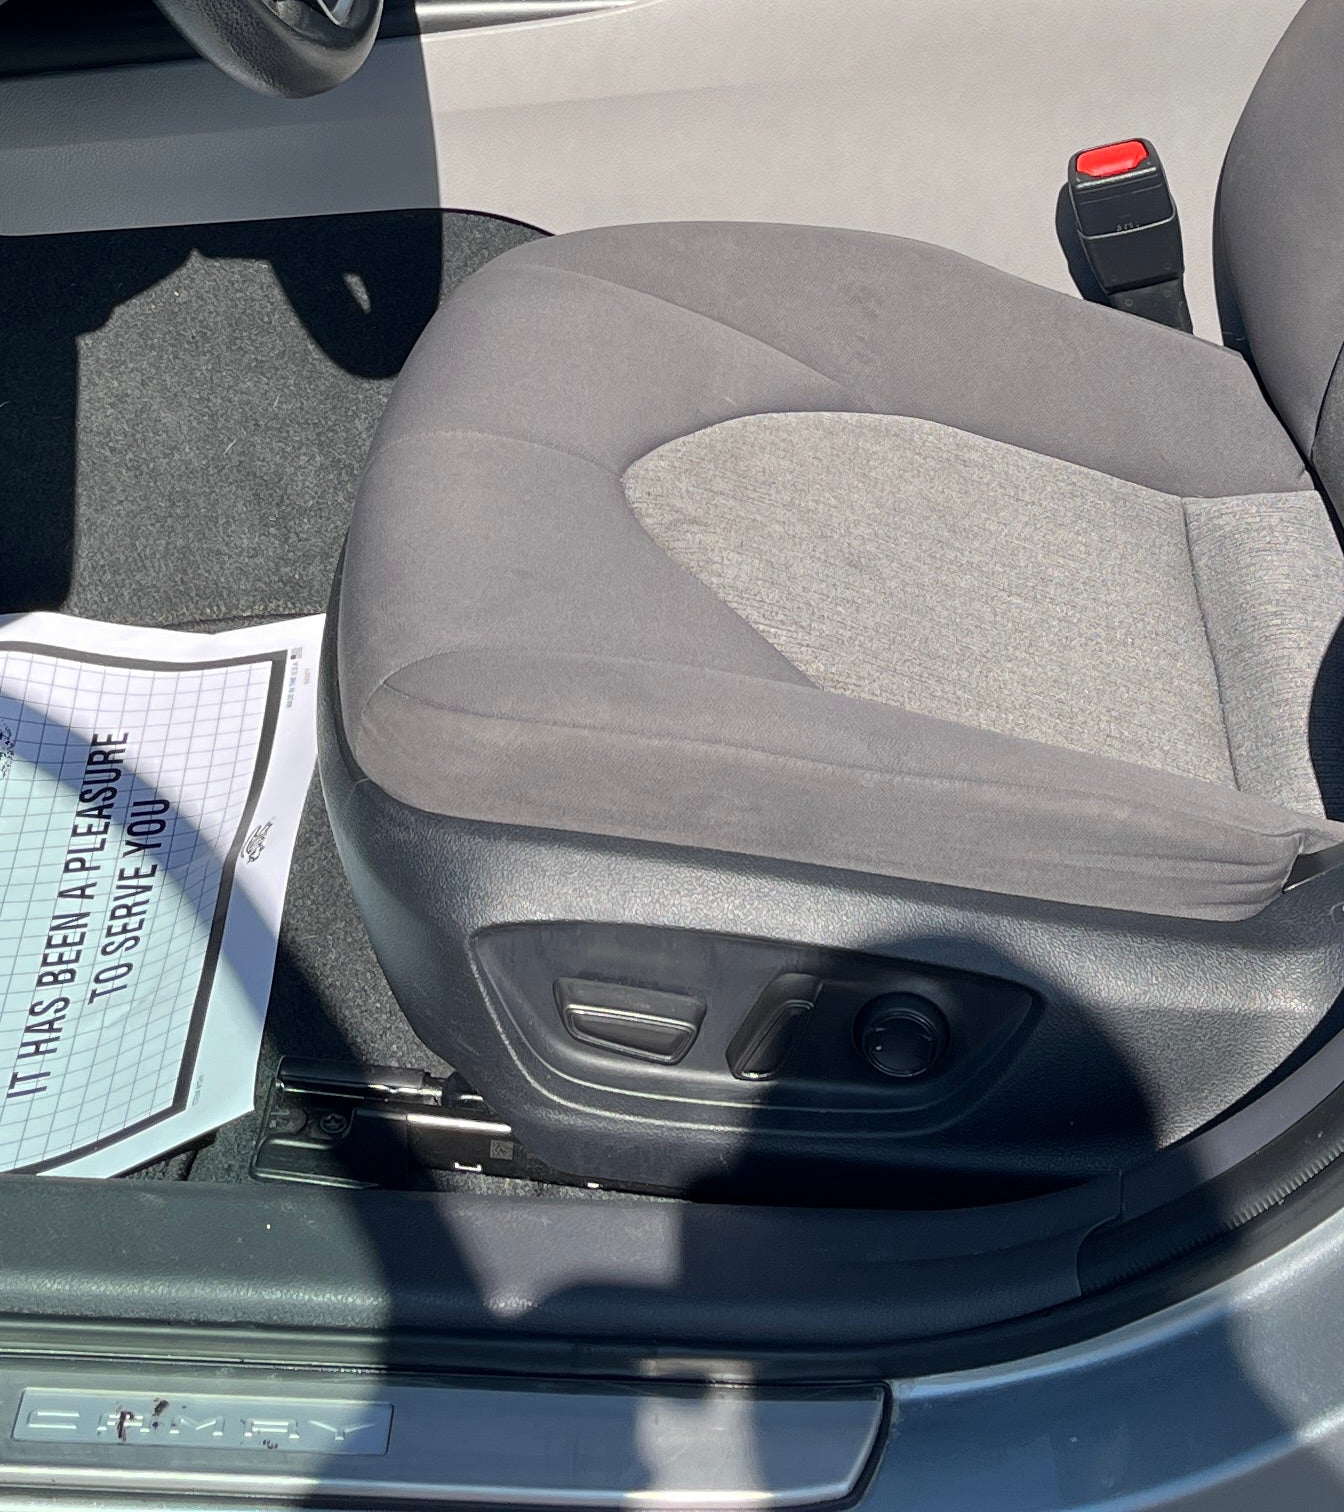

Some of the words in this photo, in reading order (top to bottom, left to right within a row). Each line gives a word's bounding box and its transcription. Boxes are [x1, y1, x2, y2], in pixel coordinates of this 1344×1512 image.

[64, 731, 129, 875] PLEASURE
[123, 798, 171, 859] YOU
[58, 881, 98, 900] A
[101, 862, 158, 952] SERVE
[36, 911, 91, 988] BEEN
[88, 962, 134, 1005] TO
[16, 996, 71, 1060] HAS
[6, 1071, 51, 1099] IT
[25, 1407, 375, 1442] CAMRY
